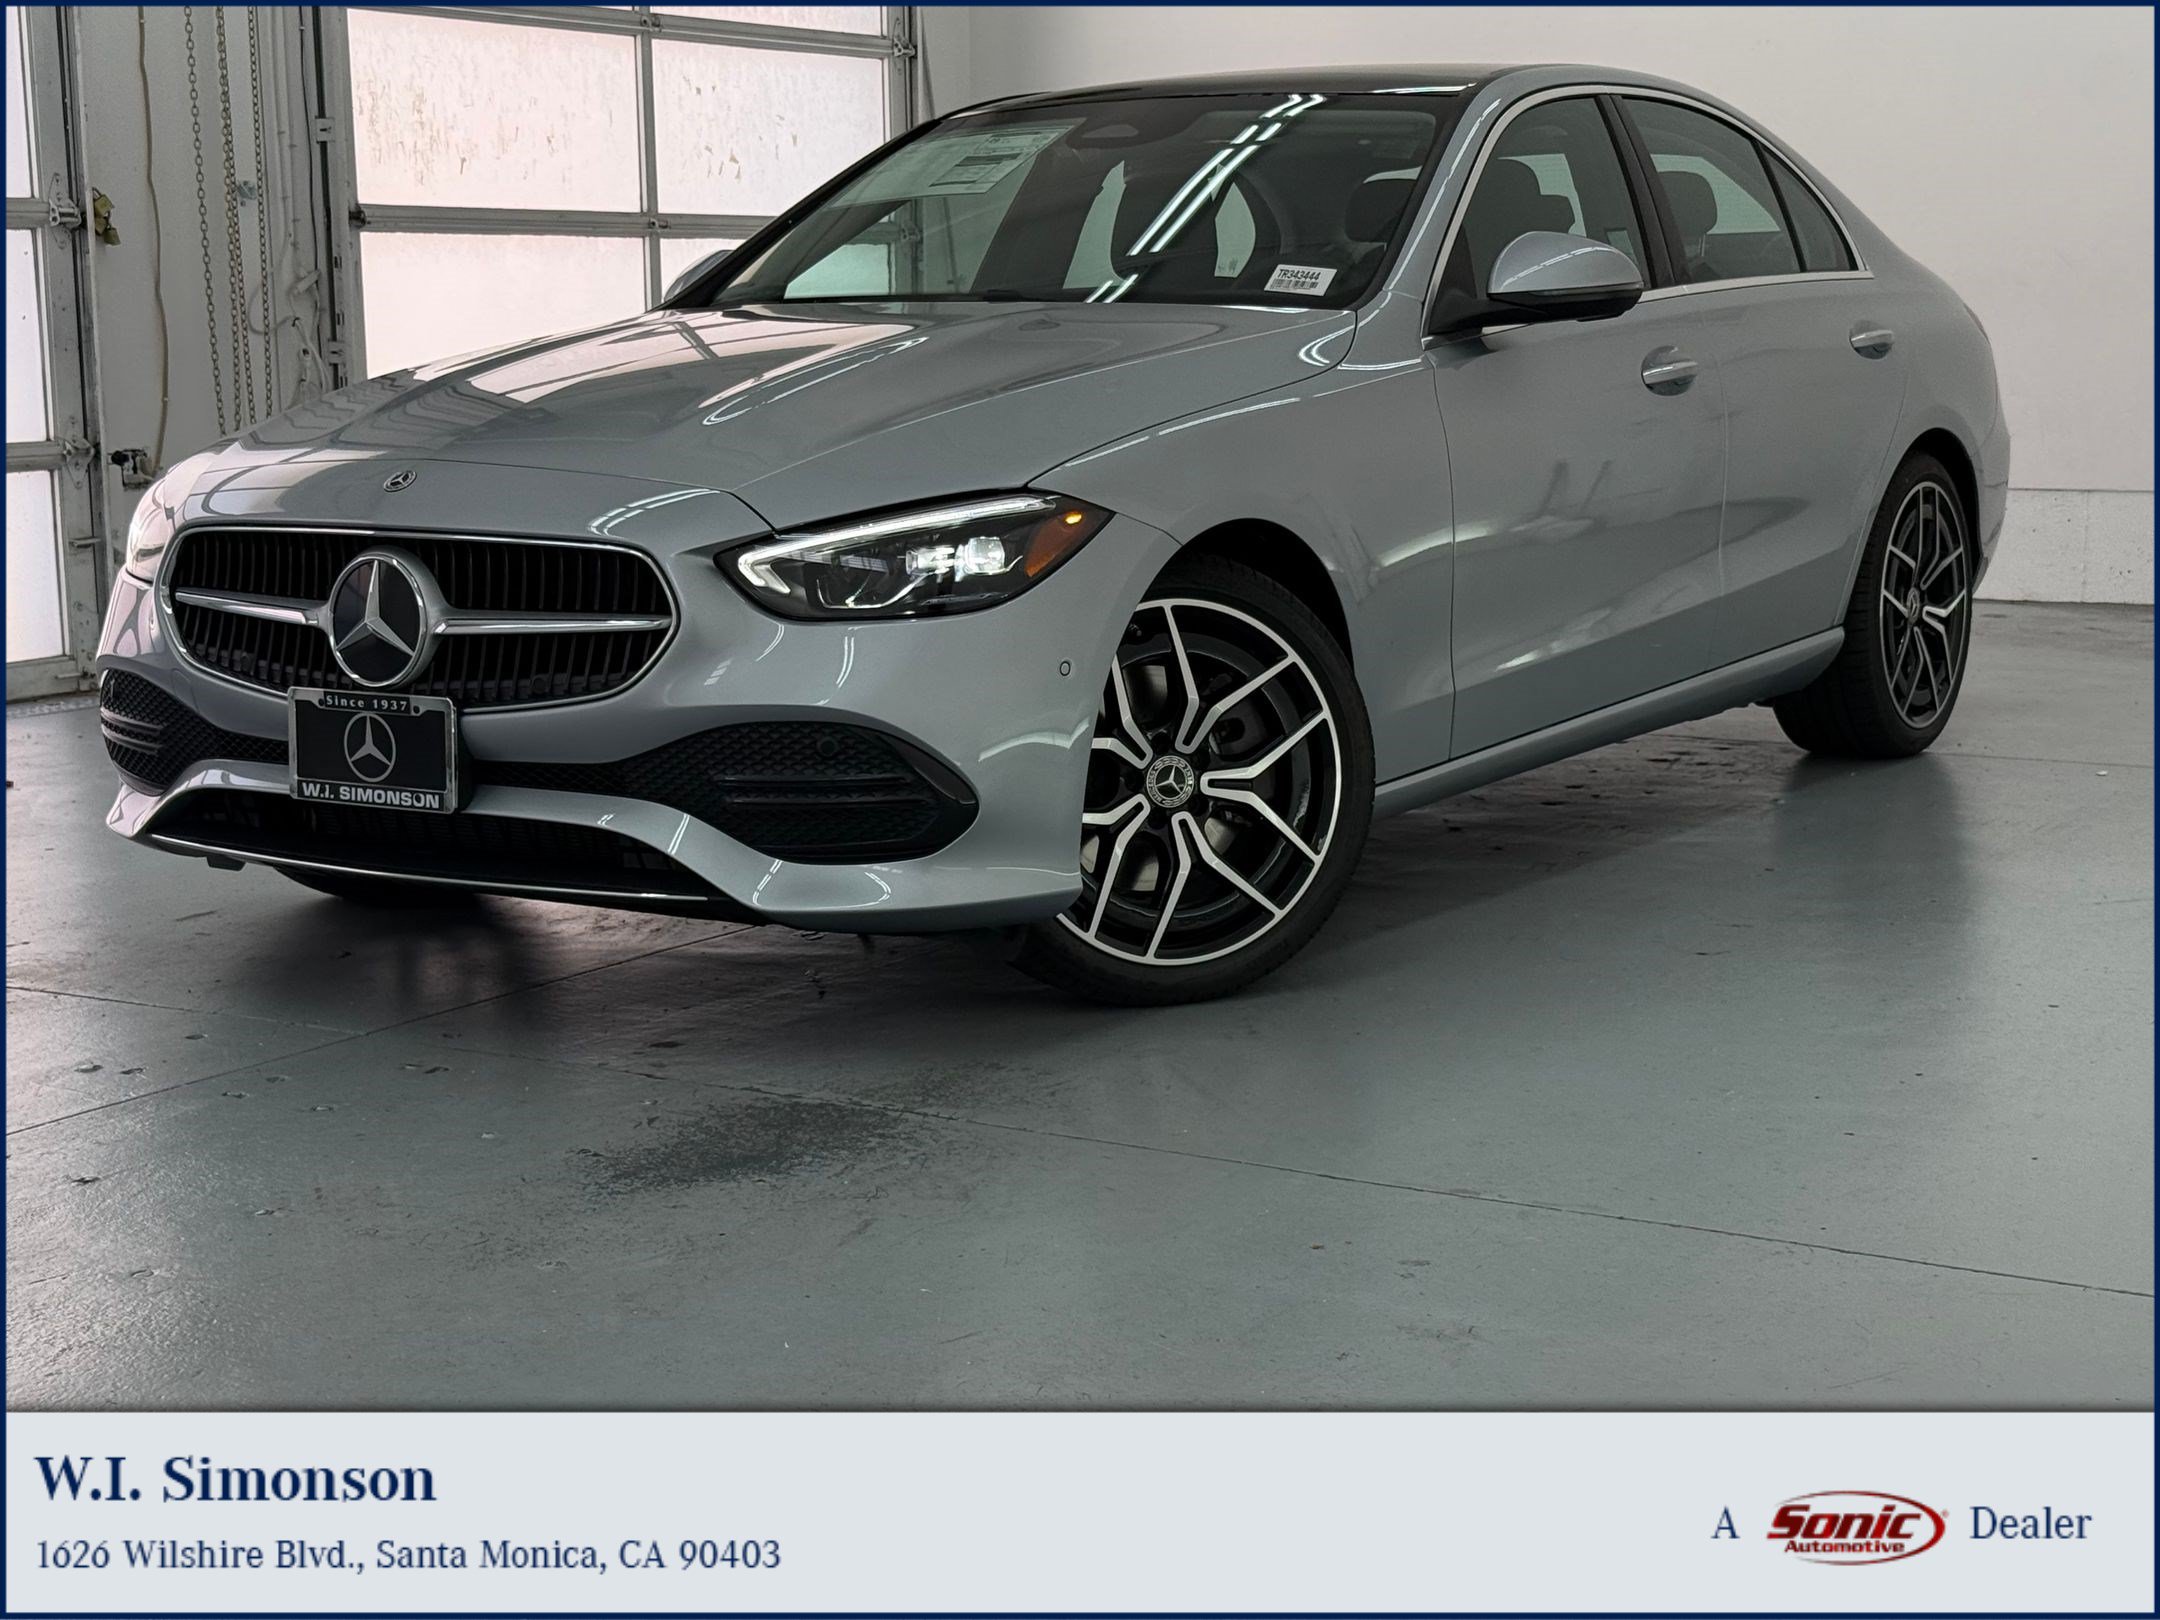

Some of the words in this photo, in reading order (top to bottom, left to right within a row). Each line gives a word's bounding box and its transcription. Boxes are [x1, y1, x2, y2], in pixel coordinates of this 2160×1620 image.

[1277, 269, 1321, 281] TR343444
[326, 695, 365, 708] Since
[373, 699, 408, 711] 1937
[302, 782, 334, 799] W.I.
[339, 786, 440, 809] SIMONSON
